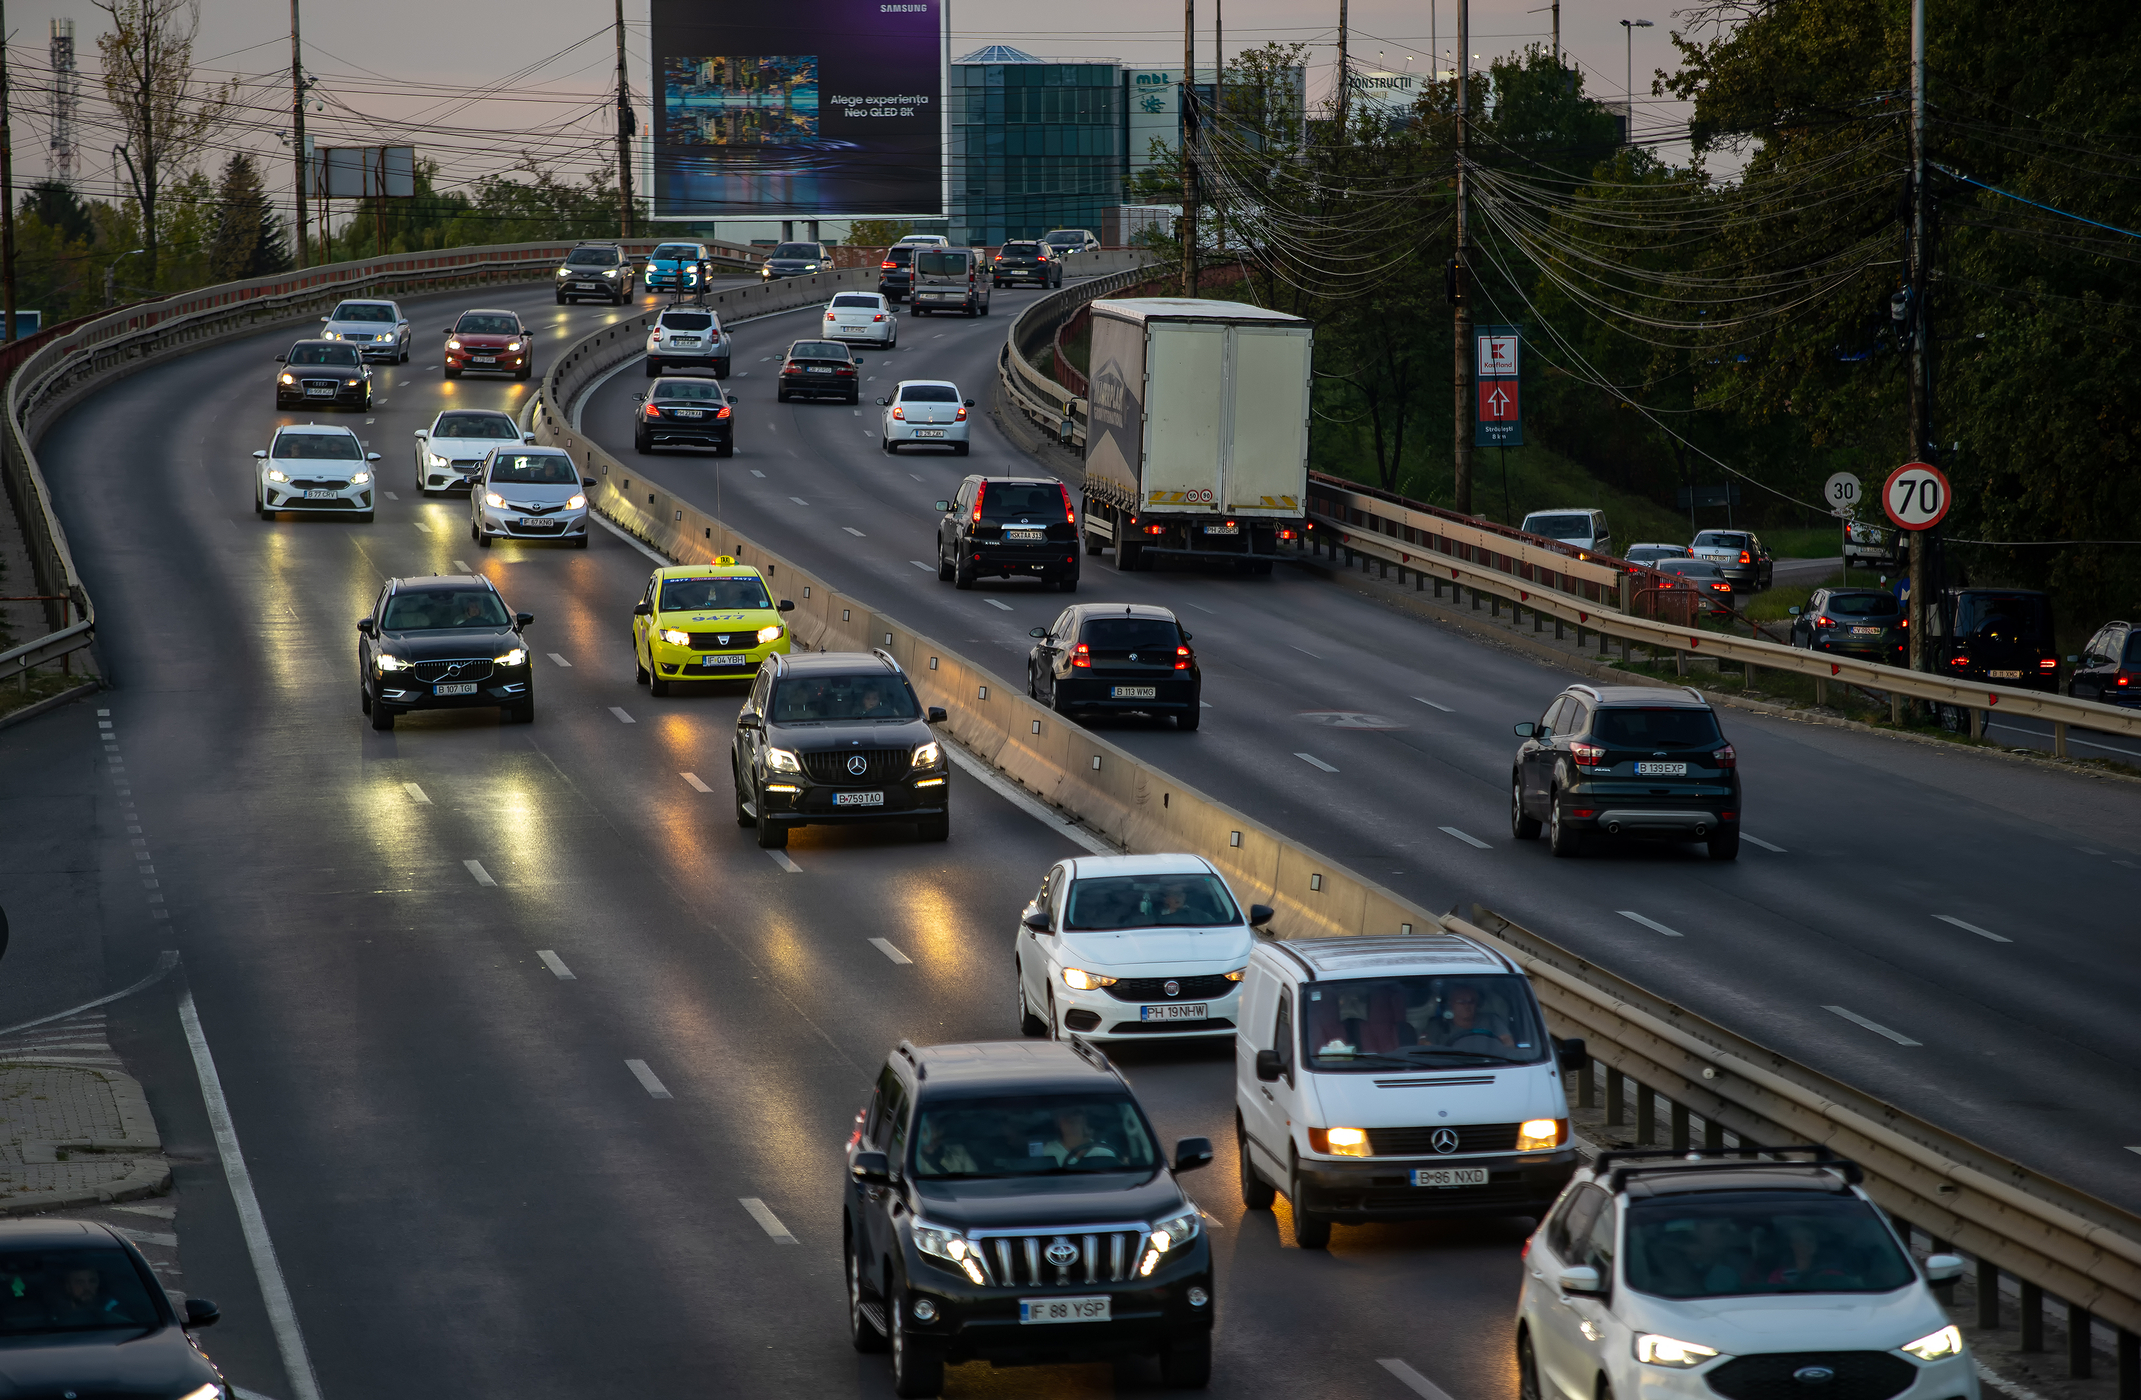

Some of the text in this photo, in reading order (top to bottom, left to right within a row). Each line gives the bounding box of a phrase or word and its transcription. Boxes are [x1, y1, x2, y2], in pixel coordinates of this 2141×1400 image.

[880, 4, 928, 13] SAMSUNG
[1136, 74, 1169, 84] mbt
[866, 94, 929, 106] experiența
[845, 106, 915, 118] Neo QLED 8K
[1834, 482, 1854, 498] 30
[1898, 478, 1938, 515] 70
[1640, 764, 1646, 772] B
[1650, 764, 1663, 772] 139
[865, 794, 881, 802] TAO
[1147, 1006, 1204, 1018] PH 19 NHW
[1420, 1170, 1484, 1184] B 86 NXD
[1030, 1302, 1105, 1319] IF 88 YSP
